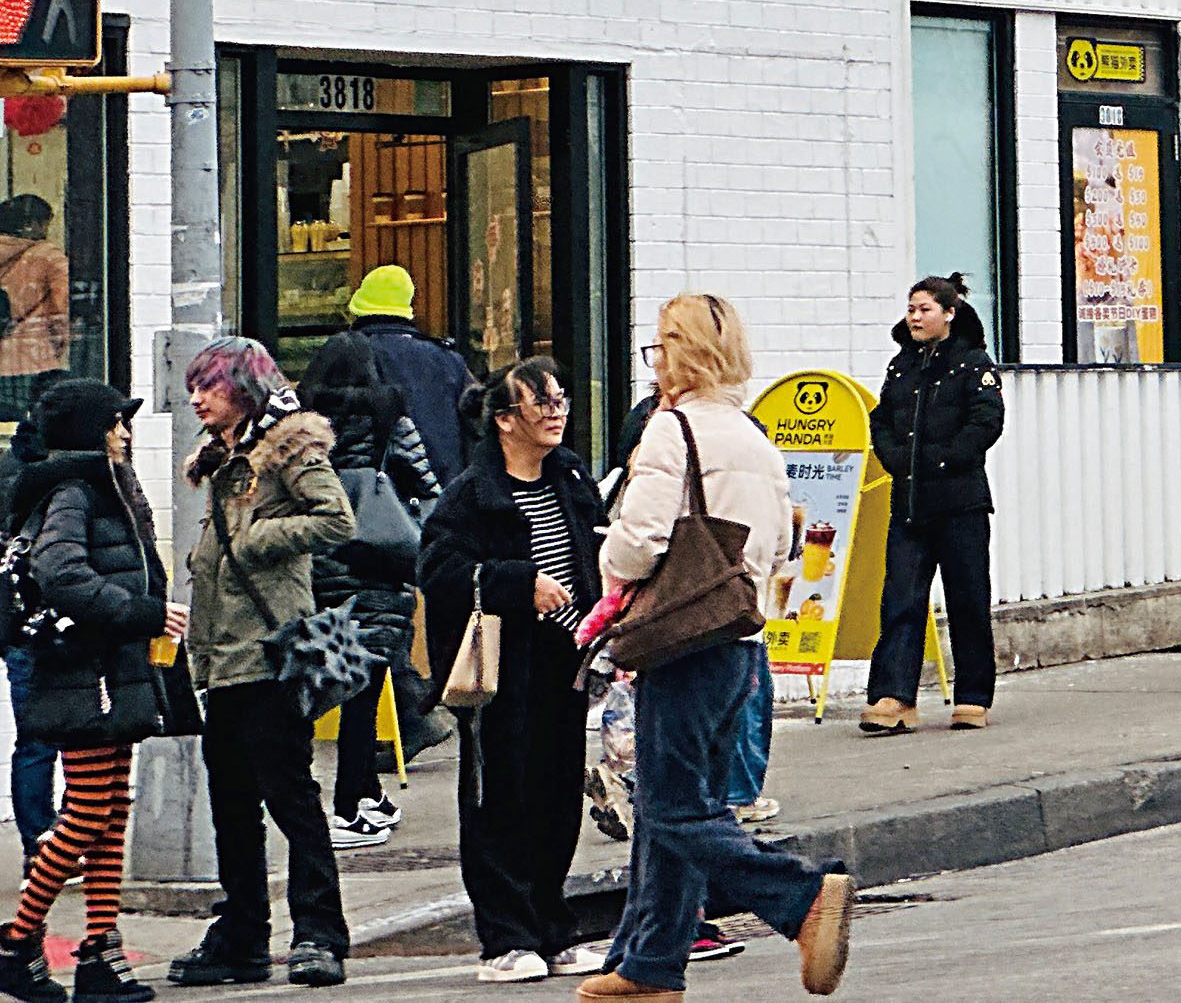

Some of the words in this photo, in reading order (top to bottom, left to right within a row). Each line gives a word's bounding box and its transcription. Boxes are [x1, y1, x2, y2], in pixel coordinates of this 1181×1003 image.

[319, 75, 375, 110] 3818
[776, 418, 836, 432] HUNGRY
[774, 432, 822, 446] PANDA
